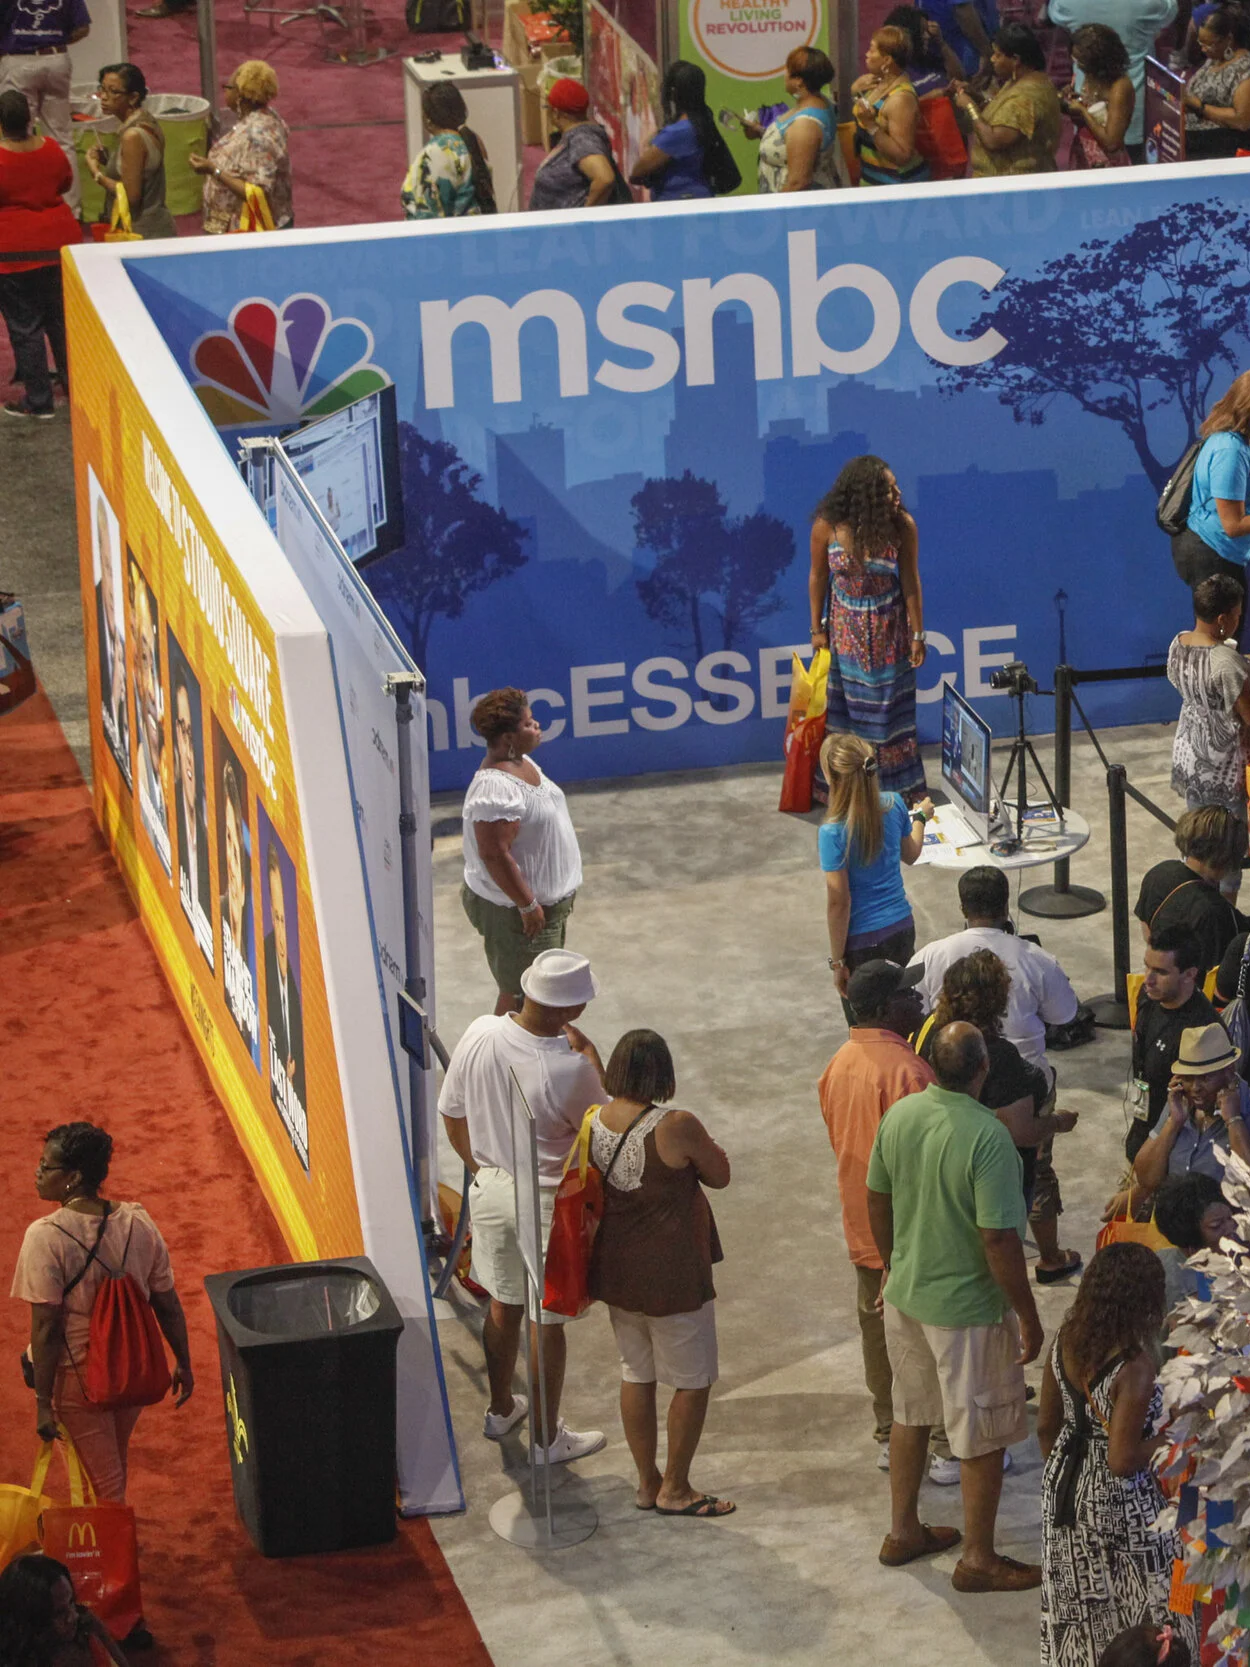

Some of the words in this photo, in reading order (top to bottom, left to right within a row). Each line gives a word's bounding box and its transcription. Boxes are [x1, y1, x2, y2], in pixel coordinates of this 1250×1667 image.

[705, 20, 807, 34] REVOLUTION
[729, 9, 782, 21] LIVING
[420, 229, 1009, 410] msnbc
[181, 503, 224, 649] STUDIO
[224, 581, 275, 743] SQUARE
[240, 703, 278, 801] msnbc
